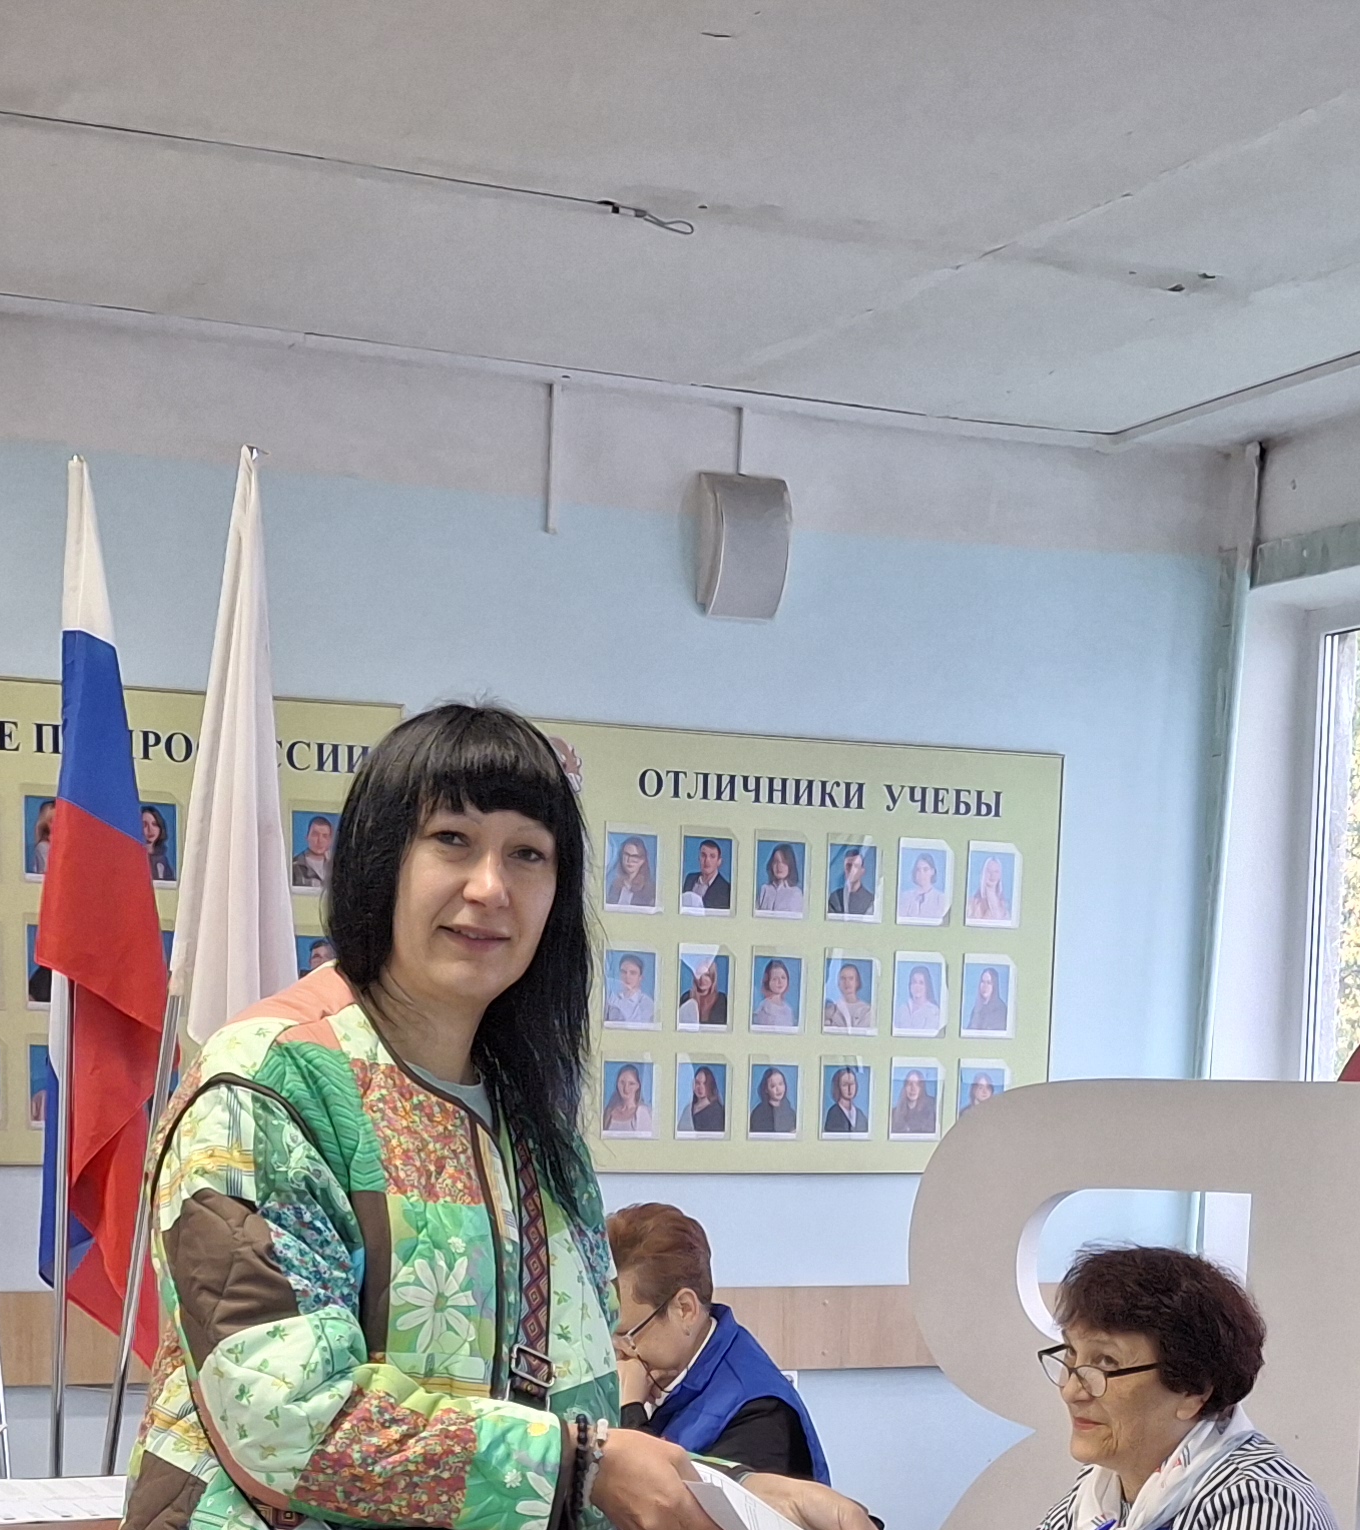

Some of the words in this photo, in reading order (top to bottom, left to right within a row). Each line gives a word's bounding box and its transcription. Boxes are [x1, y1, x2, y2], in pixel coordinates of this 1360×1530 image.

[129, 729, 372, 775] РОСИИ
[638, 767, 867, 810] ОТЛИЧНИКИ
[883, 783, 1004, 818] УЧЕБЫ
